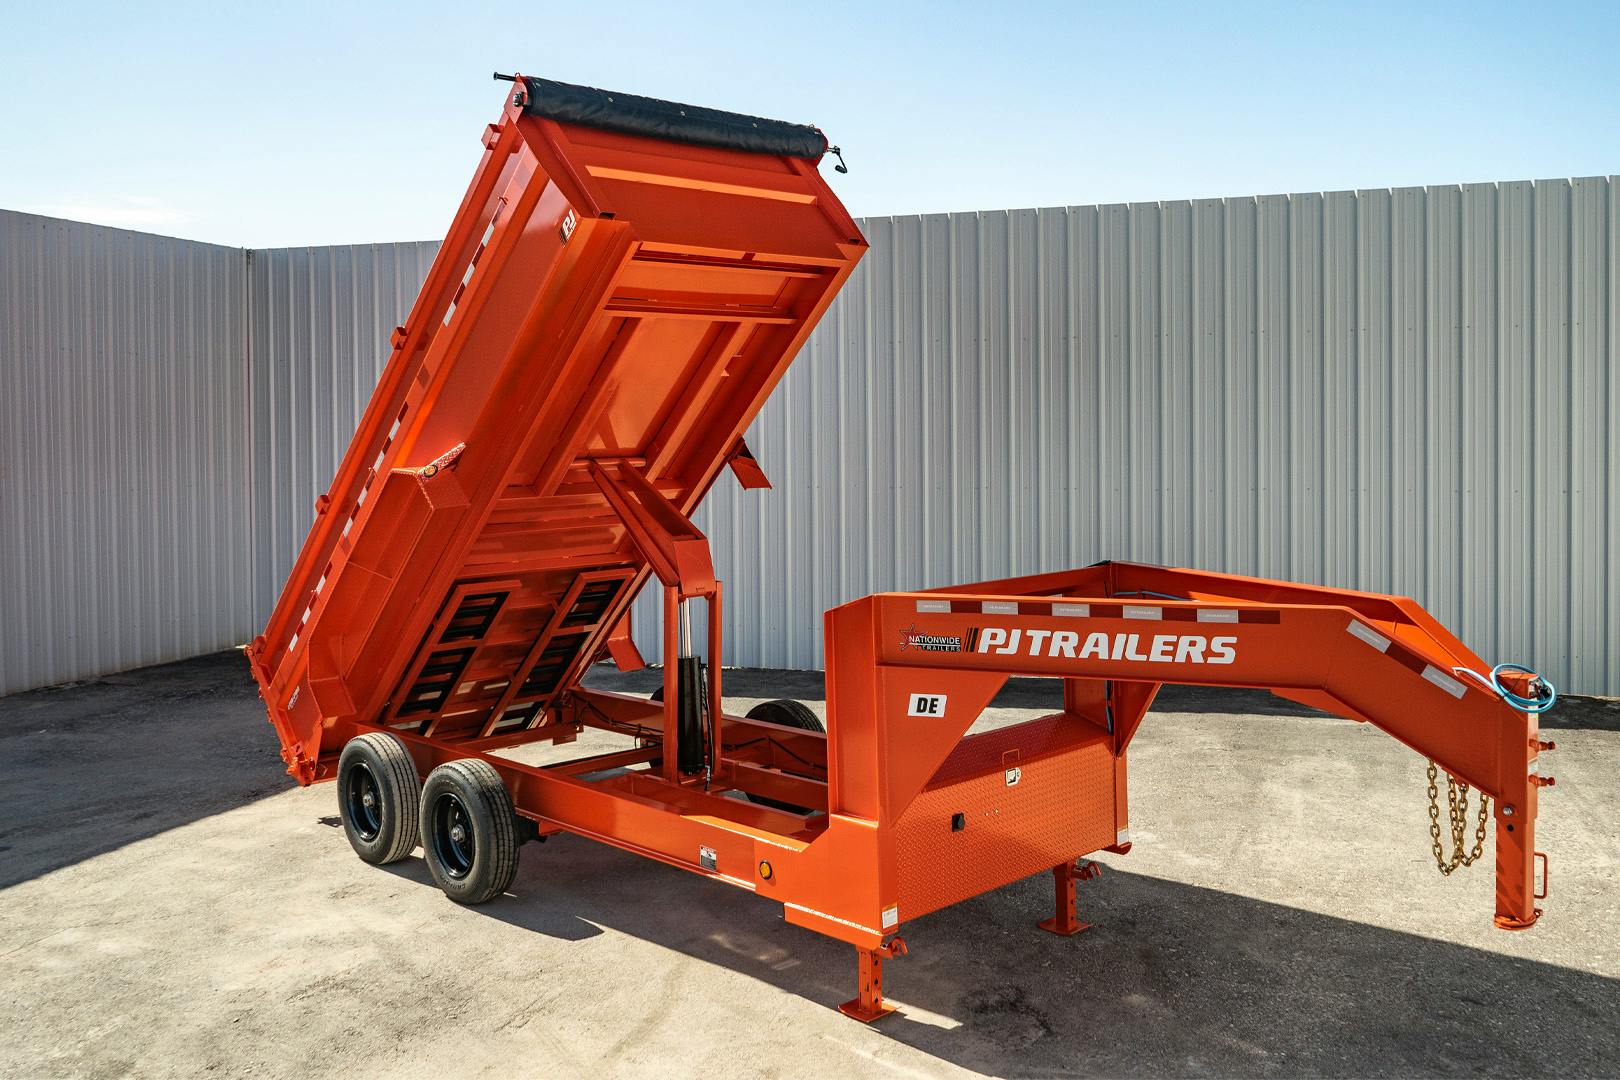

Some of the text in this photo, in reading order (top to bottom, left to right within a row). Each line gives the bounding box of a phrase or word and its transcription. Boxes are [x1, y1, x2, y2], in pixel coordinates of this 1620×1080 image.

[562, 208, 576, 236] PJ
[908, 635, 961, 645] NATIONWIDE
[978, 628, 1238, 664] PJ TRAILERS
[916, 697, 938, 714] DE
